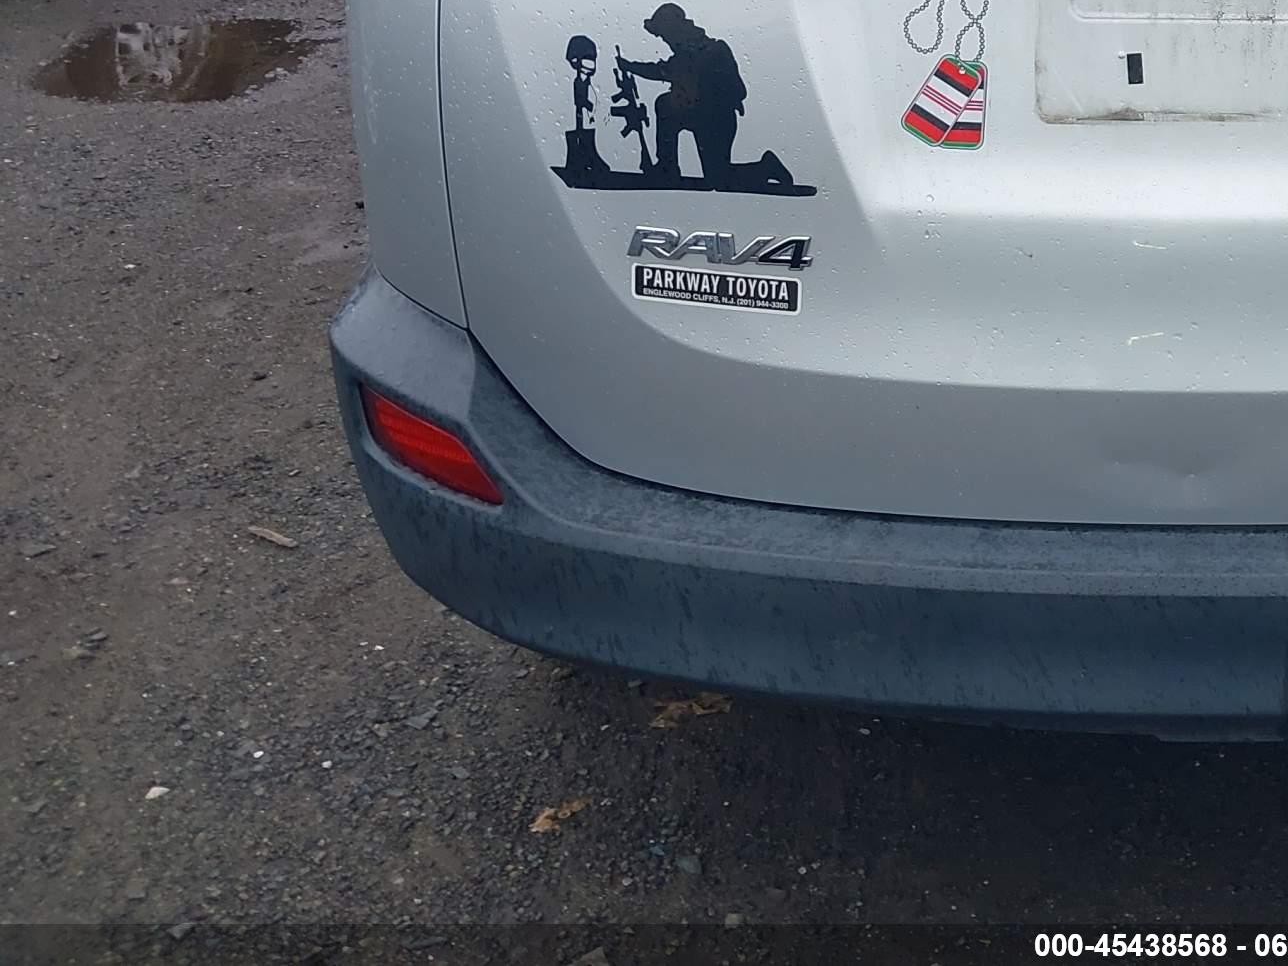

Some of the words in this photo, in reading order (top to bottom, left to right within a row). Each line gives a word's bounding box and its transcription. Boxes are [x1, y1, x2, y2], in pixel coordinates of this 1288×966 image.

[626, 225, 814, 271] RAV4
[642, 267, 720, 294] PARKWAY
[726, 276, 789, 300] TOYOTA
[642, 287, 692, 300] ENGLEWOOD
[692, 293, 721, 304] CLIFFS,
